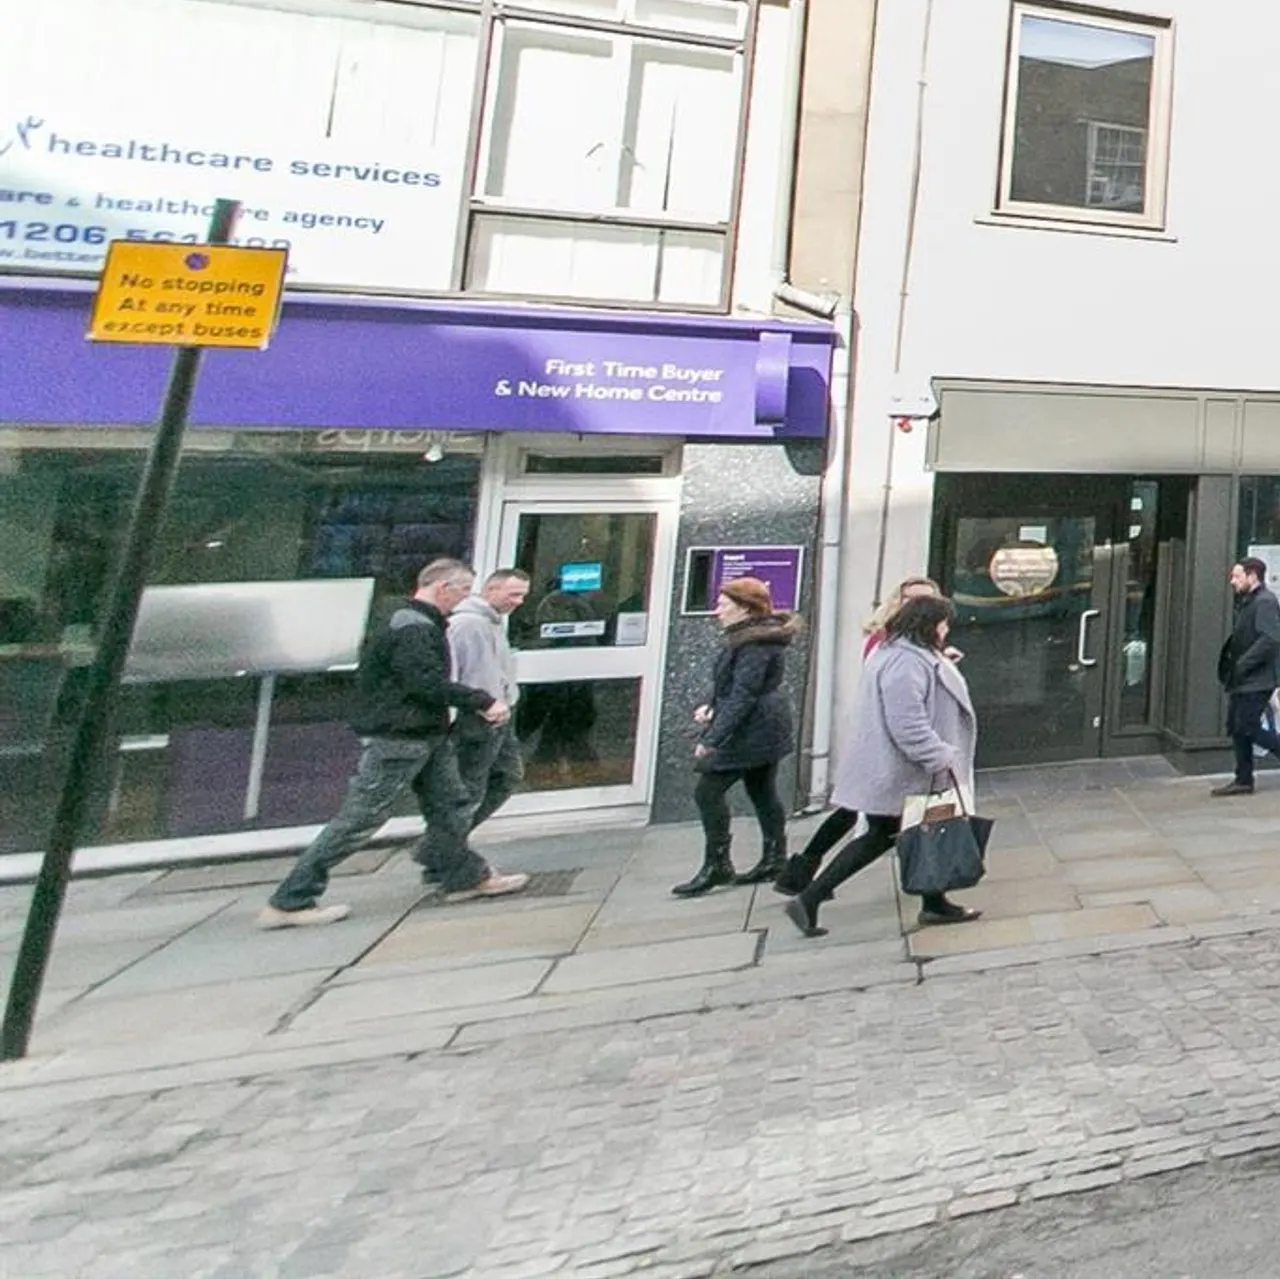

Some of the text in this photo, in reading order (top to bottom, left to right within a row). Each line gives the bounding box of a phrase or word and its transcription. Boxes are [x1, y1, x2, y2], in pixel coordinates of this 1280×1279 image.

[48, 132, 441, 187] healthcare services
[94, 192, 269, 222] healthcre
[282, 210, 385, 234] agency
[119, 273, 265, 297] No stopping
[117, 297, 257, 317] At any time
[102, 321, 263, 339] except buses
[545, 359, 724, 383] First Time Buyer
[494, 380, 722, 403] & New Home Centre
